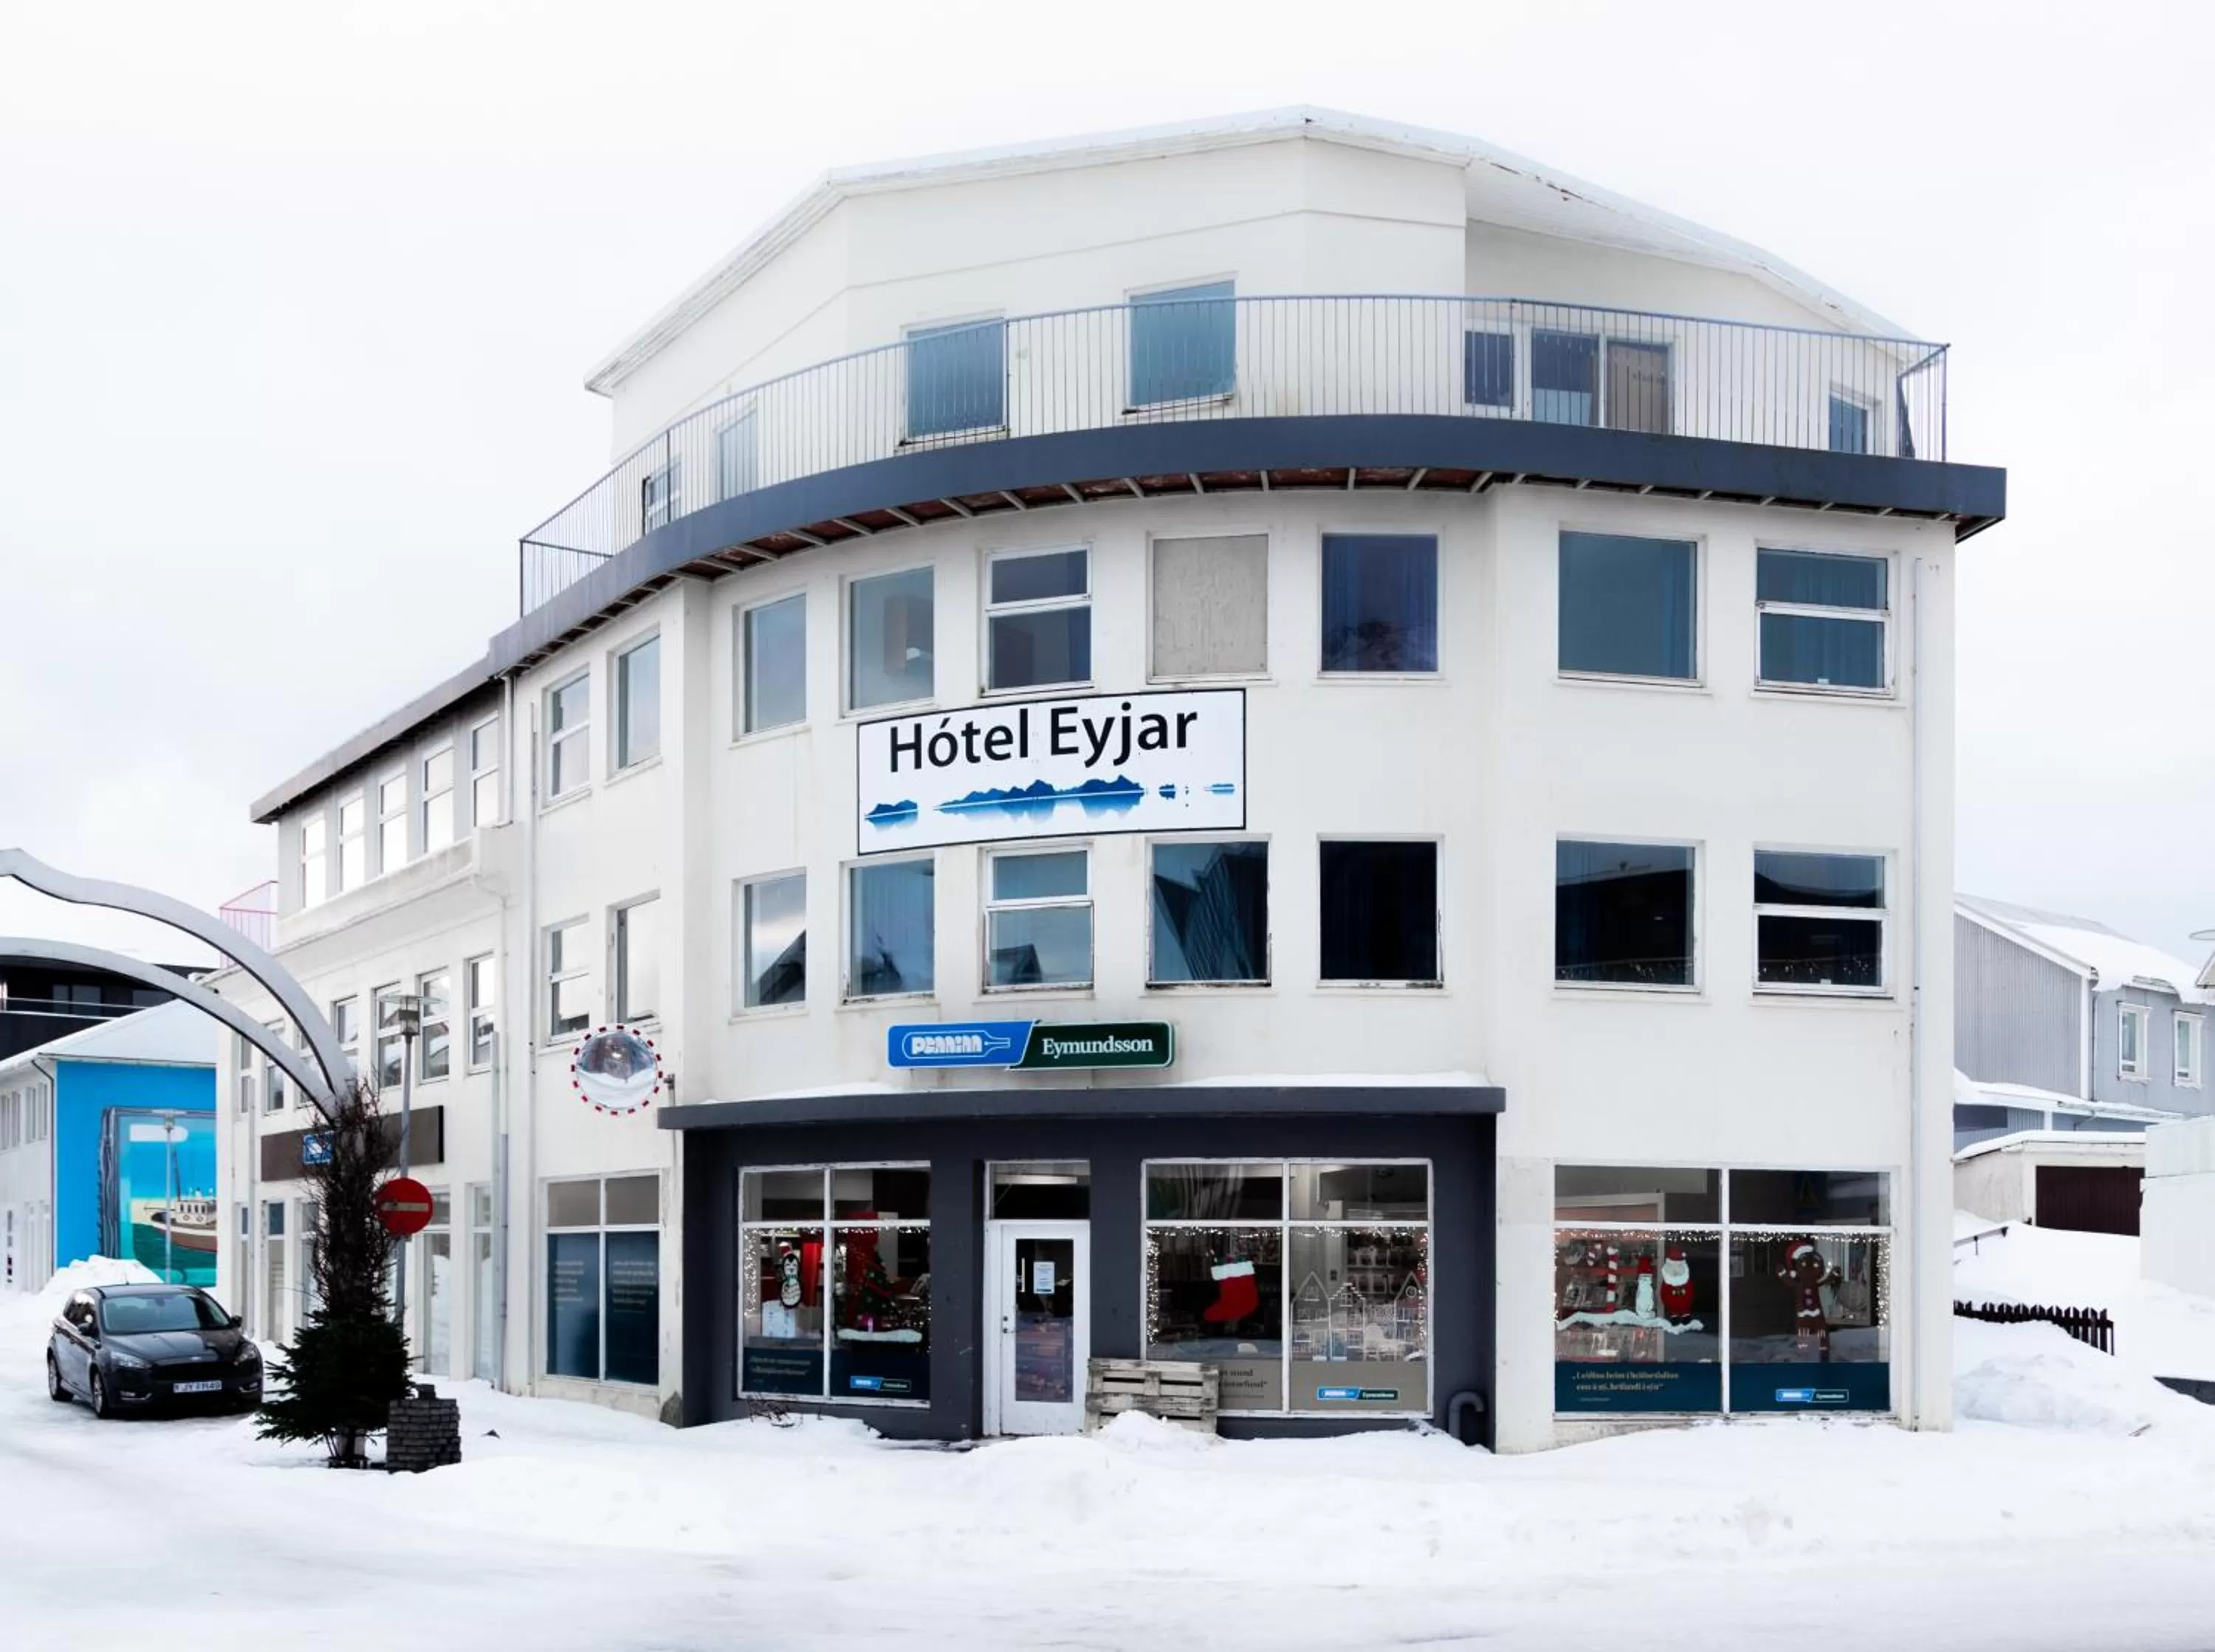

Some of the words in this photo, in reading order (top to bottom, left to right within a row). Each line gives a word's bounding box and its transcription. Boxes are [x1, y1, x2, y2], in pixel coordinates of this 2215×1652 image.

[890, 708, 1029, 773] Hótel
[1050, 701, 1198, 768] Eyjar
[1042, 1035, 1153, 1059] Eymundsson
